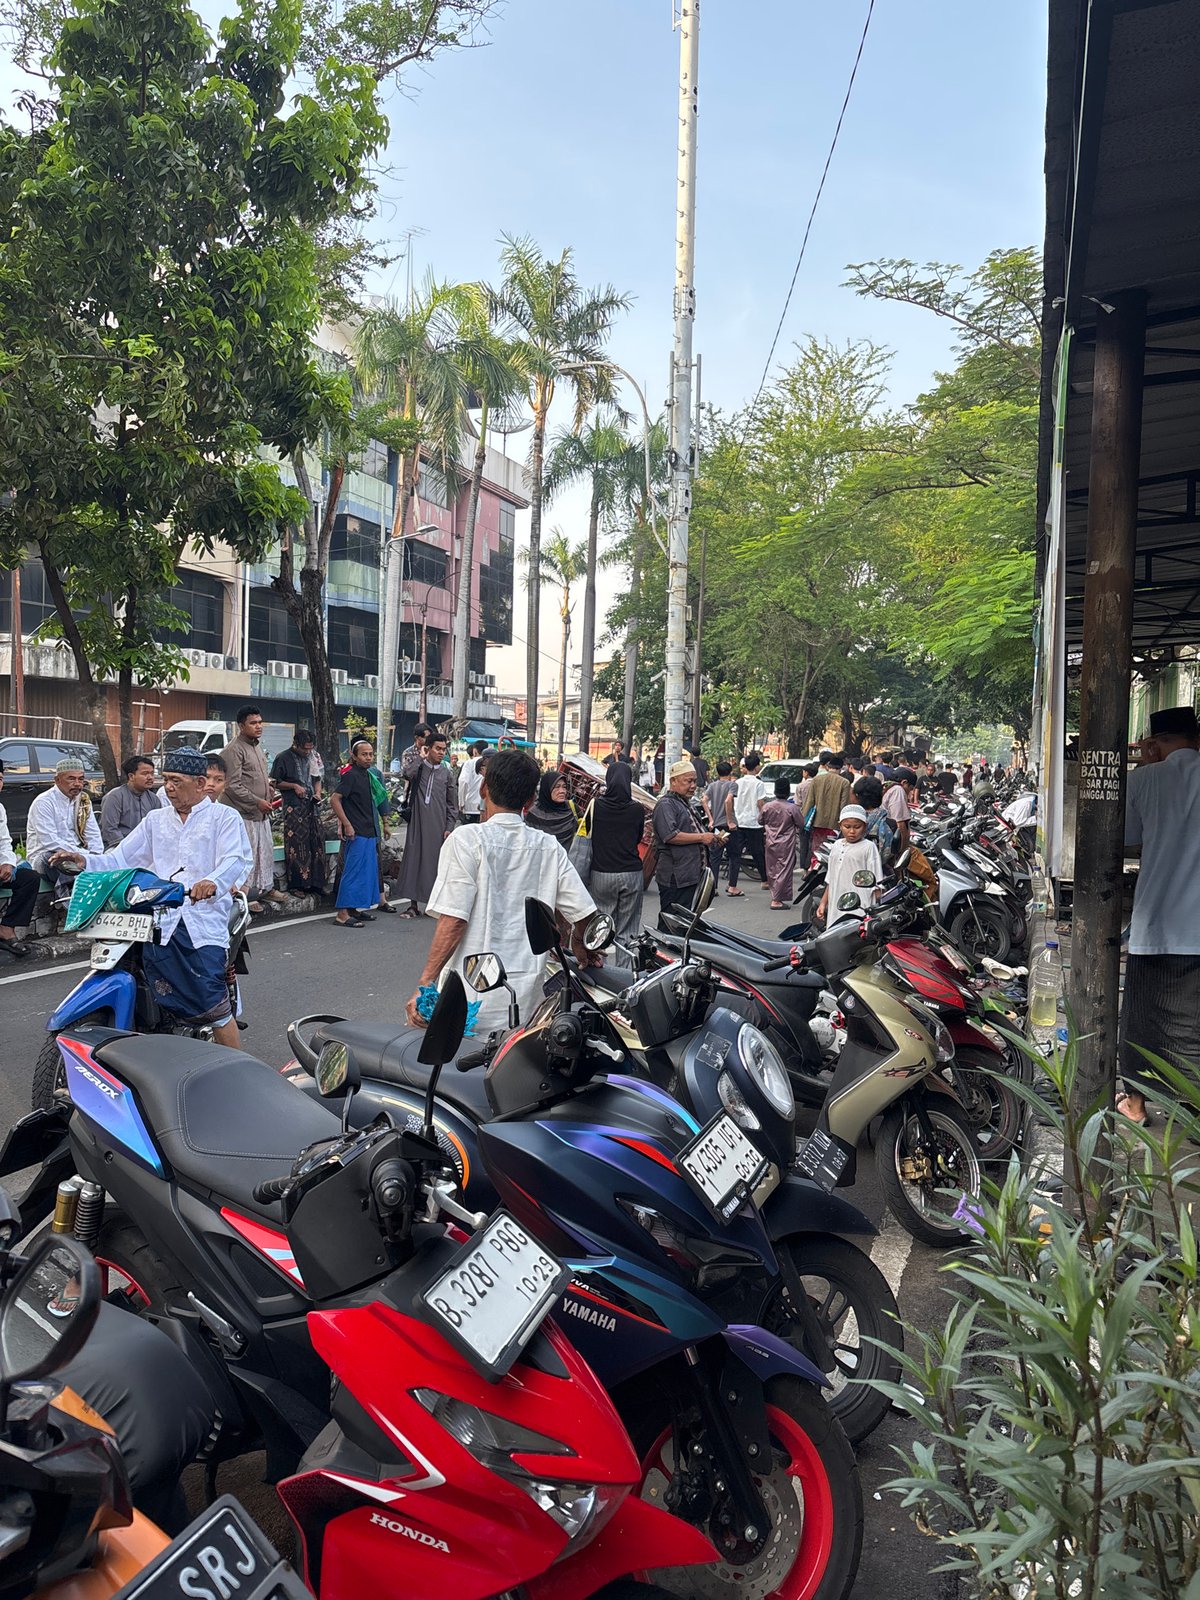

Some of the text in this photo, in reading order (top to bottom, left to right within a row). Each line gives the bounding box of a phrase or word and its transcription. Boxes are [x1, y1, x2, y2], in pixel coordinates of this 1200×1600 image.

[1081, 750, 1121, 766] SENTRA
[1081, 765, 1119, 778] BATIK
[1103, 779, 1120, 790] PAGI
[95, 914, 148, 928] 6442 BHL
[74, 1065, 120, 1100] AEROX
[686, 1162, 706, 1186] B
[717, 1121, 744, 1150] UFL
[798, 1161, 814, 1176] B
[450, 1251, 500, 1307] 3287
[562, 1297, 617, 1332] YAMAHA
[369, 1512, 451, 1554] HONDA
[179, 1523, 256, 1600] SRJ
